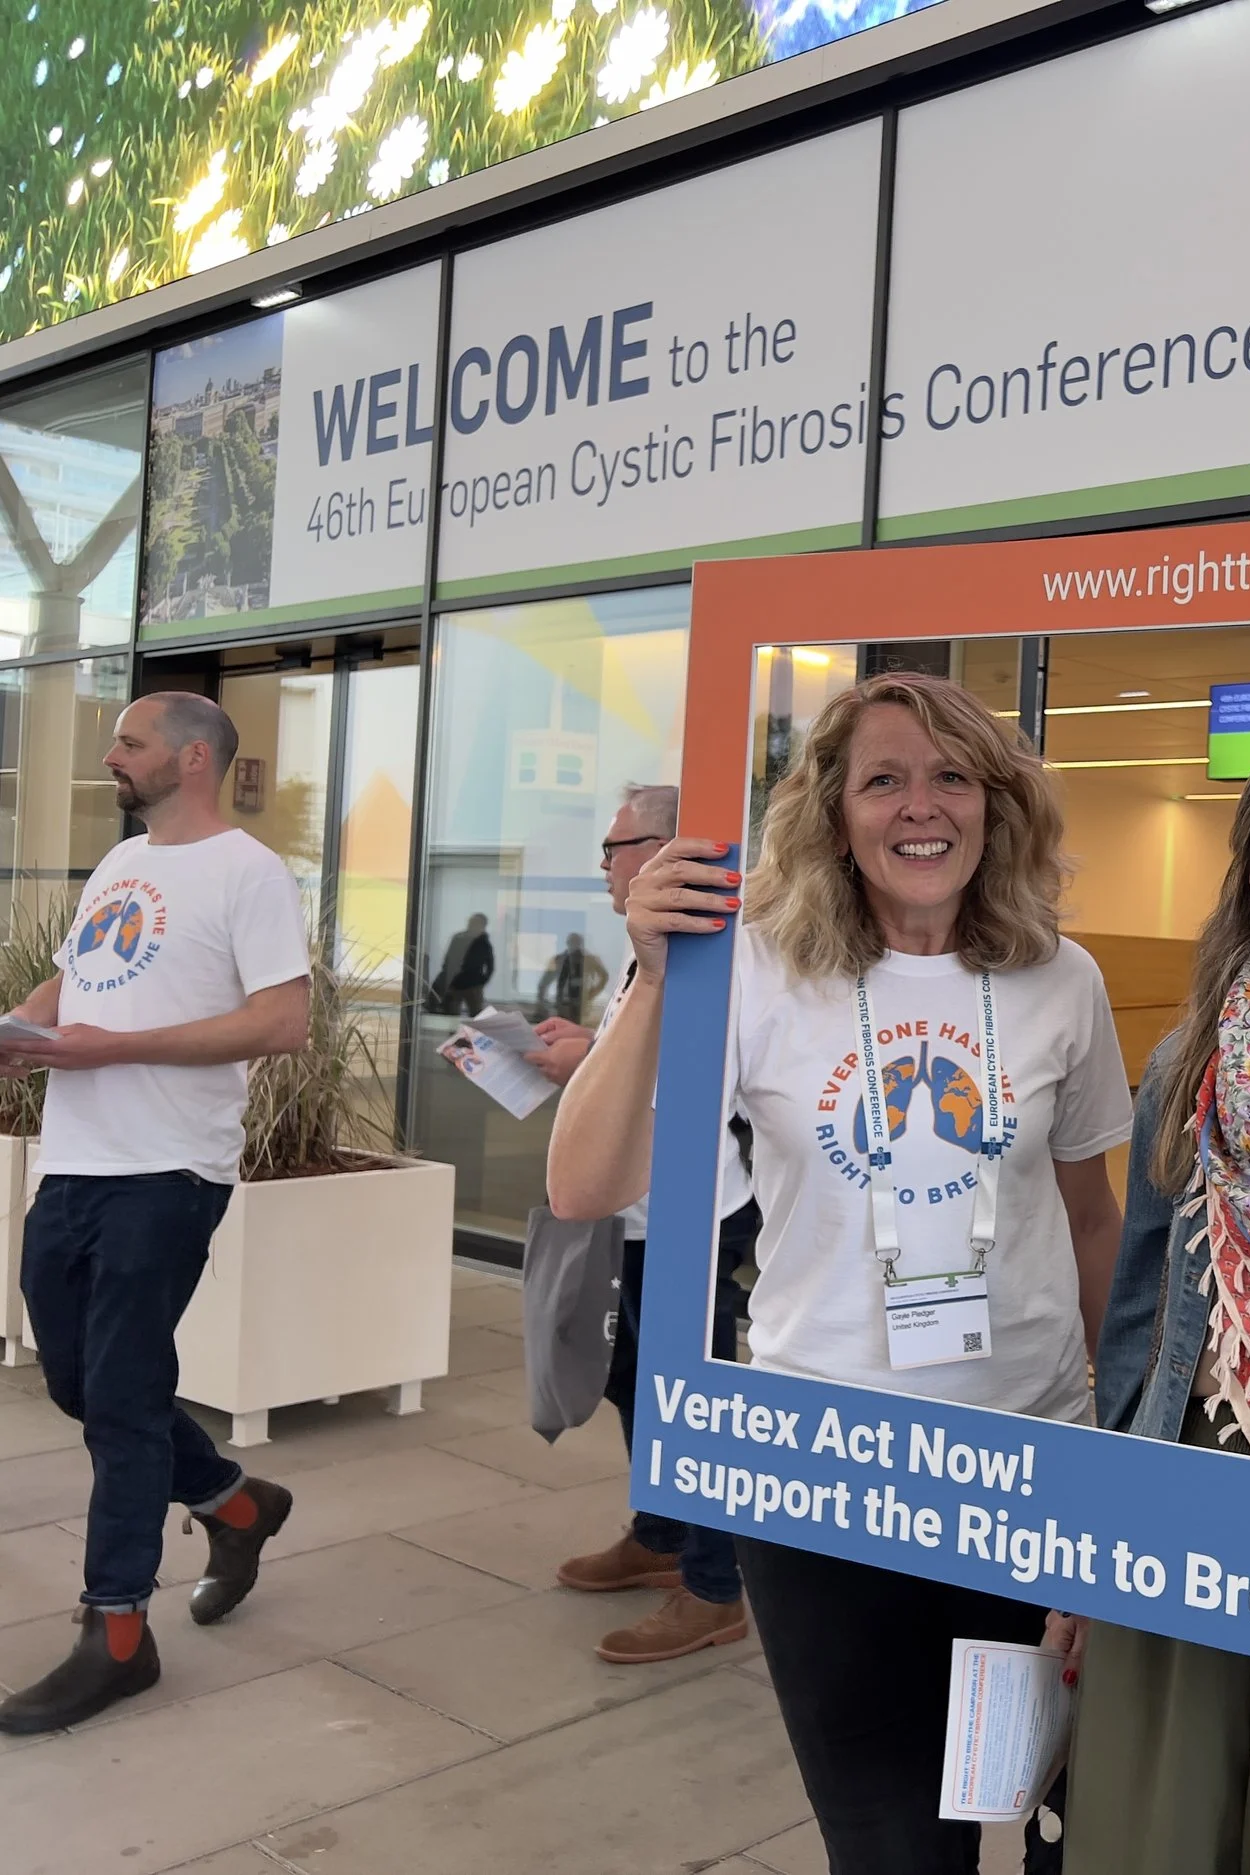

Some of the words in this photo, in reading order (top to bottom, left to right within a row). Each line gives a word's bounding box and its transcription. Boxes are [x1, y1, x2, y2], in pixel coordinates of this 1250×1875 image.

[313, 301, 653, 467] WELCOME
[668, 335, 709, 388] to
[724, 312, 797, 375] the
[306, 487, 375, 543] 46th
[386, 462, 557, 530] European
[570, 423, 694, 508] Cystic
[709, 381, 905, 472] Fibrosis
[140, 881, 163, 903] HAS
[152, 906, 167, 935] THE
[77, 978, 92, 992] TO
[96, 941, 161, 993] BREATHE
[858, 990, 869, 1022] CYSTIC
[983, 994, 994, 1036] FIBROSIS
[818, 1020, 929, 1111] EVERONE
[1000, 1065, 1016, 1105] HE
[861, 1024, 875, 1067] FIBROSIS
[986, 1038, 996, 1071] CYSTIC
[866, 1069, 884, 1139] CONFERENCE
[988, 1074, 998, 1126] EUROPEAN
[816, 1123, 872, 1190] RIGHT
[893, 1187, 915, 1206] O
[927, 1115, 1018, 1206] BREHE
[892, 1322, 912, 1331] United
[913, 1319, 940, 1328] Kingdom
[653, 1374, 800, 1450] Vertex
[810, 1407, 894, 1469] Act
[907, 1422, 1036, 1497] Now!
[649, 1438, 663, 1487] I
[673, 1454, 850, 1530] support
[863, 1484, 943, 1548] the
[956, 1502, 1098, 1585] Right
[1111, 1539, 1168, 1599] to
